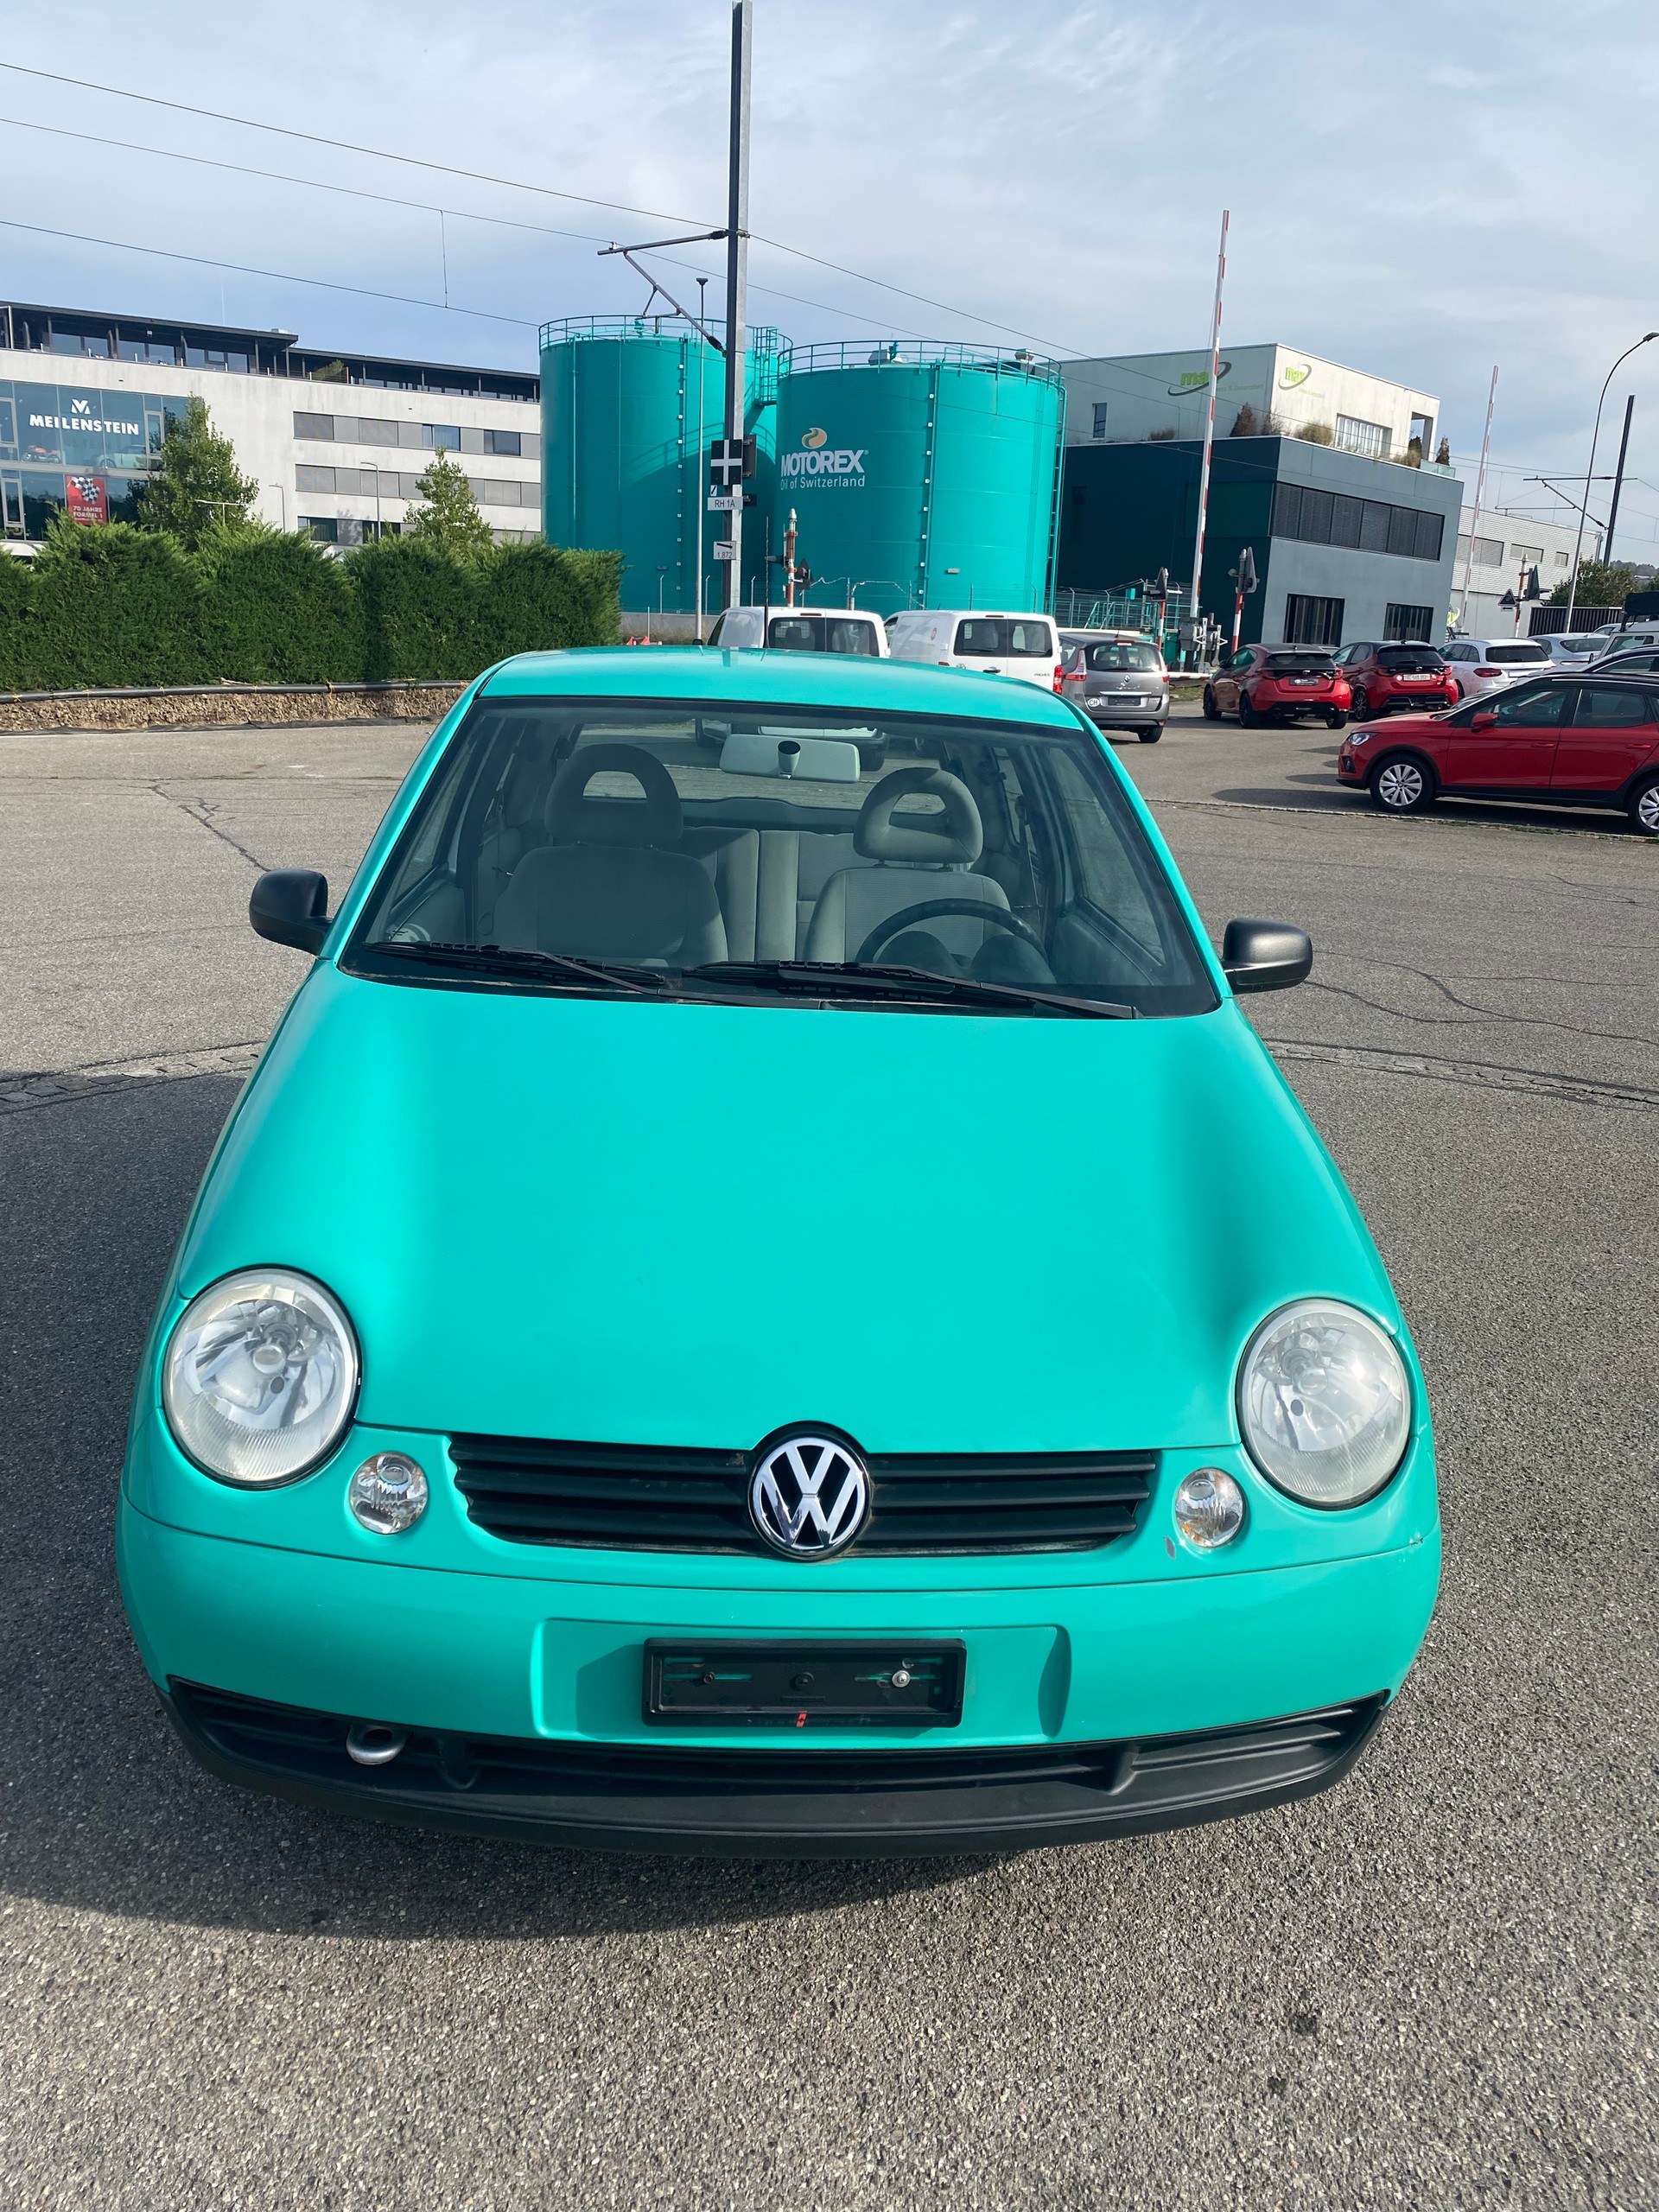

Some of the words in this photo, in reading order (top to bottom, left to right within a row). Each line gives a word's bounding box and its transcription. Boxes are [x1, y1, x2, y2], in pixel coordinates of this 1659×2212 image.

[29, 415, 138, 435] MEILENSTEIN
[790, 477, 798, 489] of
[800, 475, 865, 488] Switzerland
